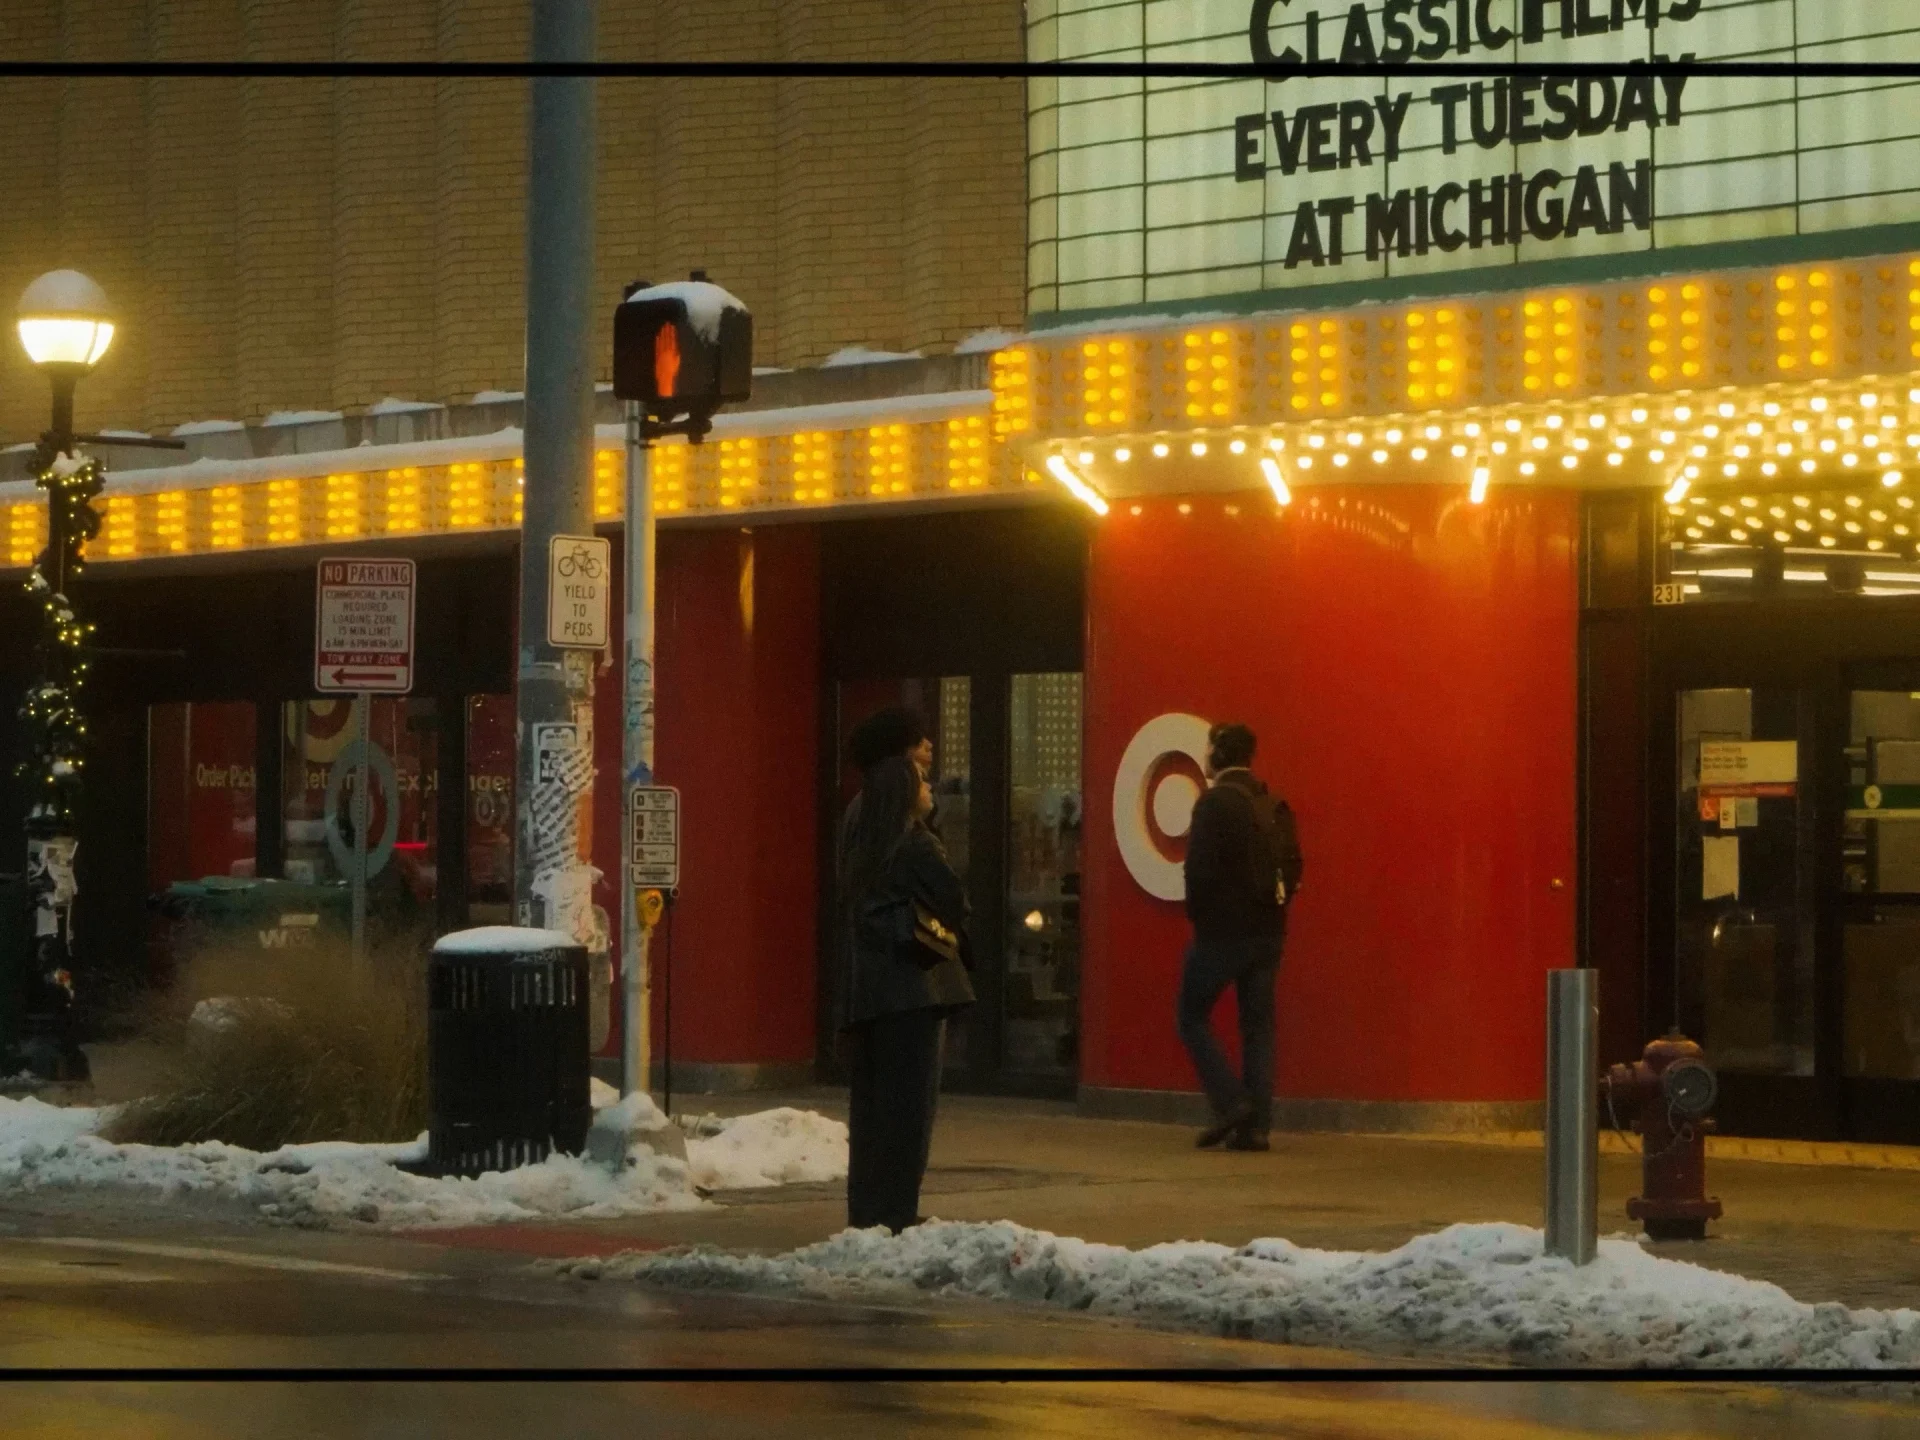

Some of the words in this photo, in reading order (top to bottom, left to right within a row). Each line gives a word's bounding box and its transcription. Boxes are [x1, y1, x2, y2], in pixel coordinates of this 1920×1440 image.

[1249, 0, 1512, 83] CLASSIC
[1235, 91, 1412, 182] EVERY
[1430, 53, 1697, 155] TUESDAY
[1284, 198, 1354, 270] AT
[1365, 158, 1652, 265] MICHIGAN
[325, 565, 343, 582] NO
[351, 565, 408, 583] PARKING
[564, 585, 595, 599] YIELD
[1655, 585, 1681, 603] 231
[573, 603, 586, 617] TO
[332, 614, 371, 625] LOADING
[374, 615, 397, 625] ZONE
[564, 622, 593, 636] PEDS
[327, 655, 345, 664] TOW
[350, 655, 373, 664] AWAY
[378, 655, 401, 664] ZONE
